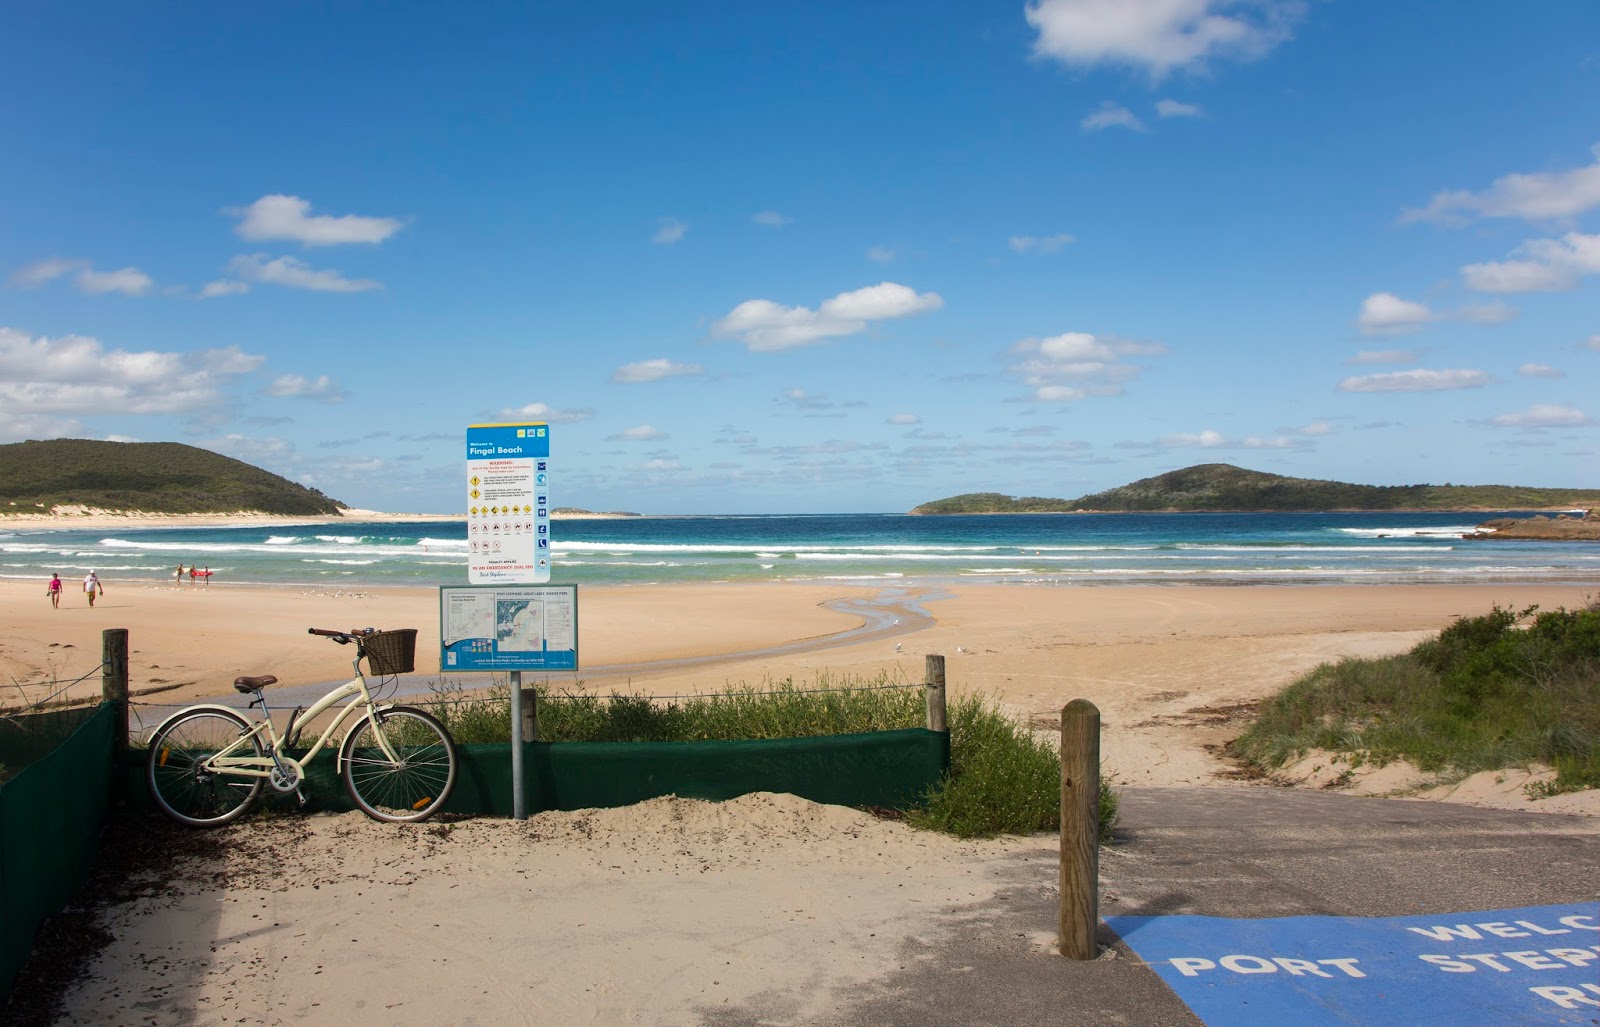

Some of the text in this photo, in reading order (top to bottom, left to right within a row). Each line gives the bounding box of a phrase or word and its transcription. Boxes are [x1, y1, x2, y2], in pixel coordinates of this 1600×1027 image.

[470, 447, 495, 456] Fingal
[1406, 916, 1600, 941] WELC
[1168, 946, 1600, 978] PORT STEP
